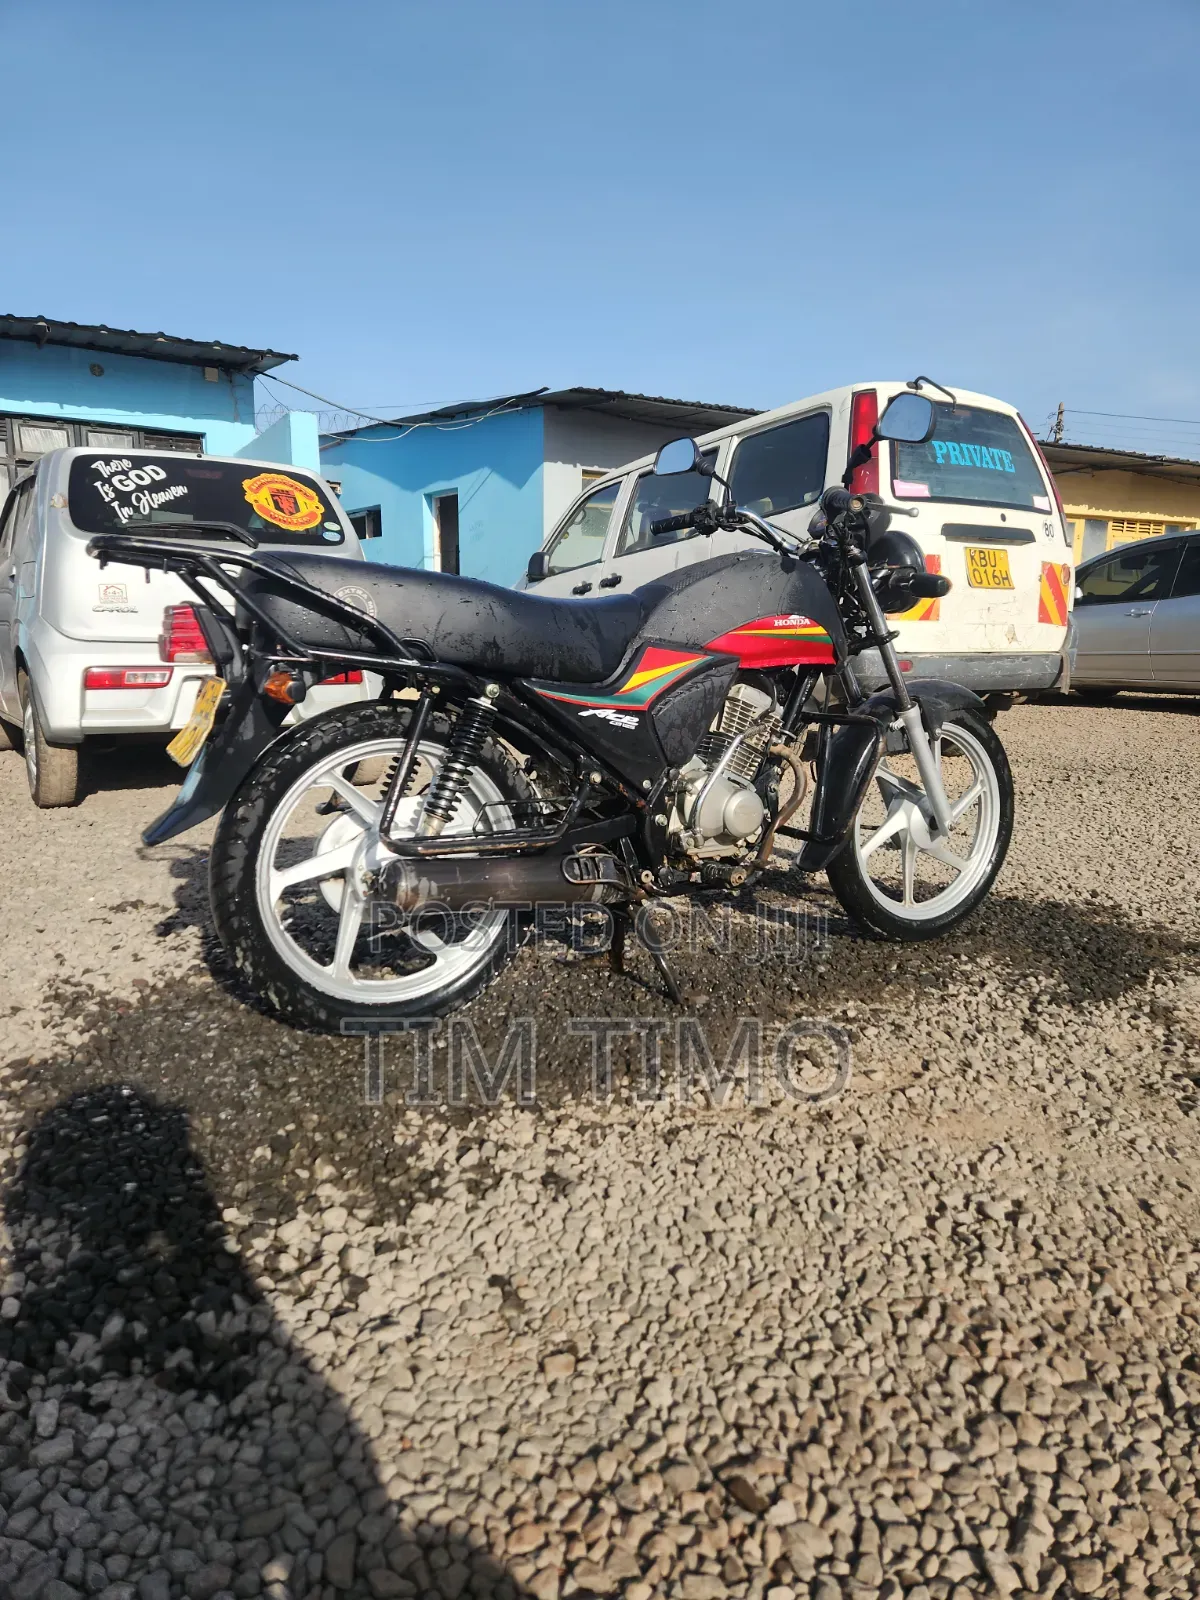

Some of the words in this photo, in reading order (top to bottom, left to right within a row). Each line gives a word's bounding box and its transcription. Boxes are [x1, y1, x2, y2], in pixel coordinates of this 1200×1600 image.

[931, 440, 1016, 473] PRIVATE
[90, 458, 132, 478] There
[93, 480, 116, 503] Is
[111, 464, 167, 492] GOD
[110, 500, 134, 524] In
[131, 483, 188, 515] Heaven
[1044, 522, 1055, 538] 80
[969, 549, 997, 569] KBU
[972, 568, 1012, 587] 016H
[337, 588, 368, 600] EXTRA
[773, 618, 811, 627] HONDA
